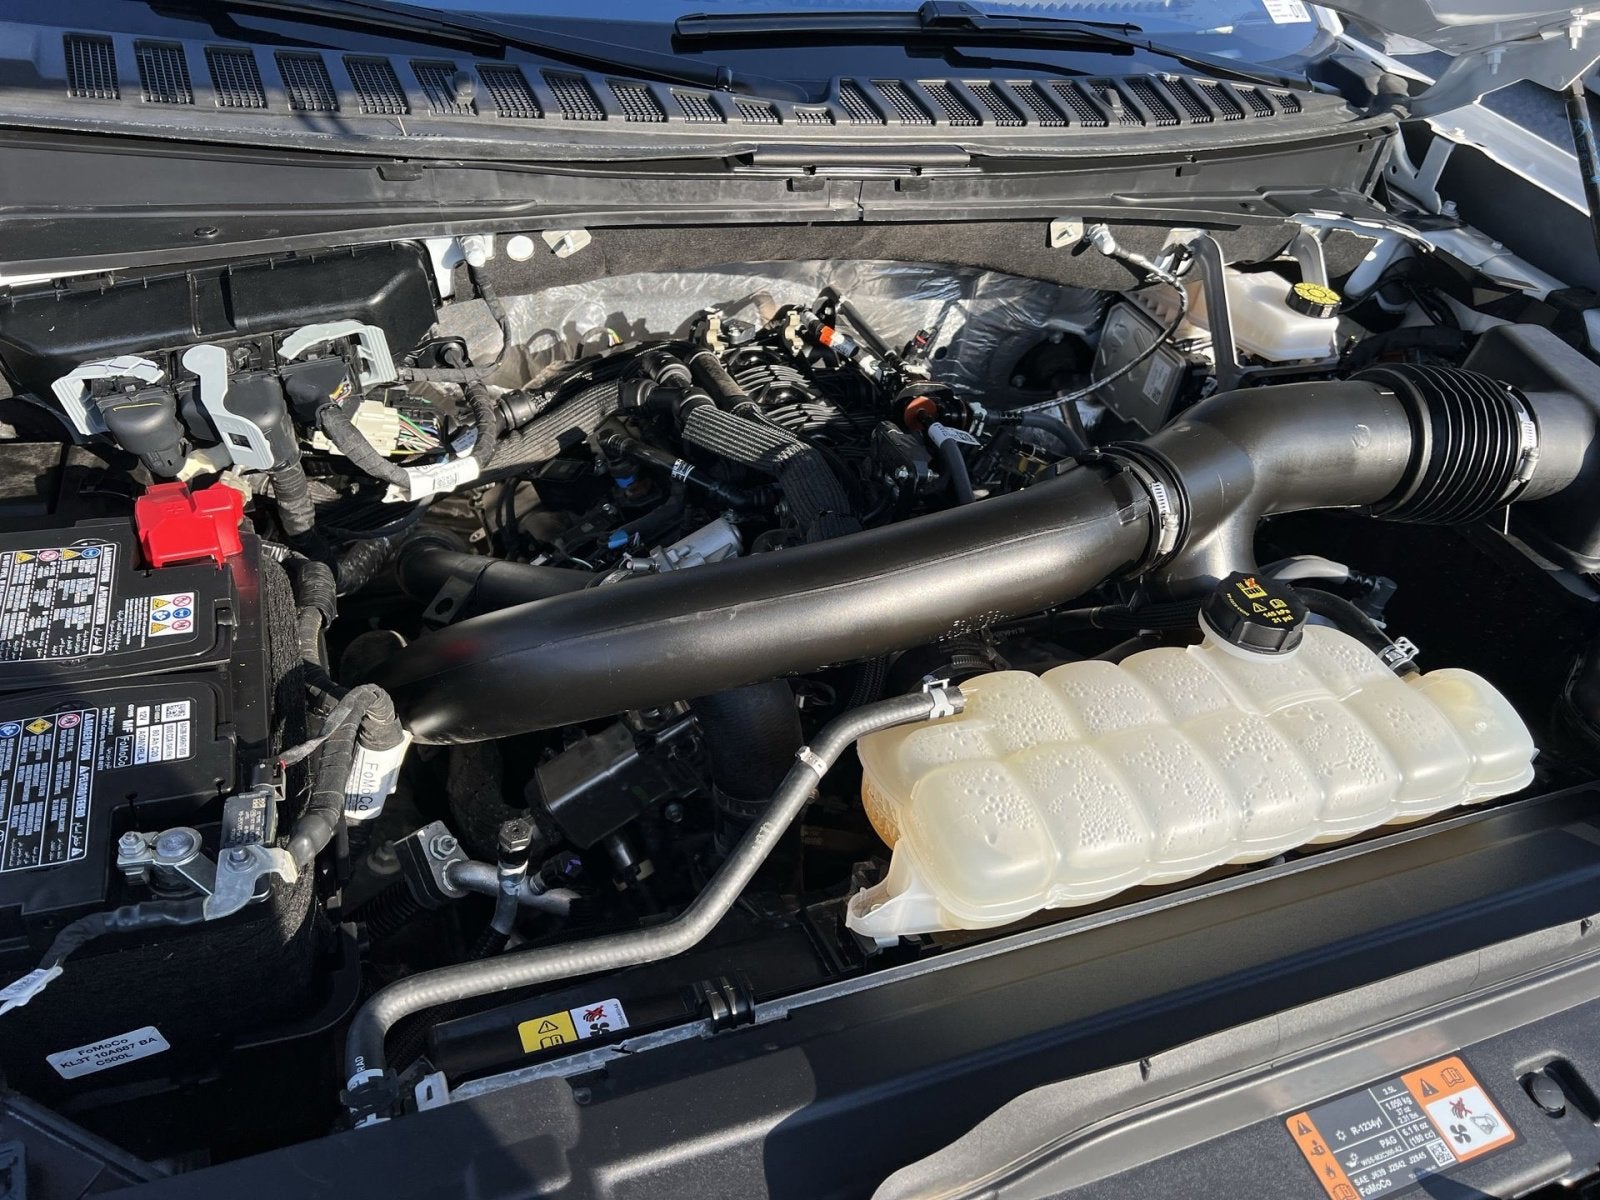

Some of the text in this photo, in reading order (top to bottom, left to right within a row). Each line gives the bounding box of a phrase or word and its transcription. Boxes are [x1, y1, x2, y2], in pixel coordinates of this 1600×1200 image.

[118, 736, 129, 766] FoMoCo
[60, 1056, 90, 1069] KL3T
[139, 1037, 158, 1046] BA
[78, 1038, 128, 1056] FoMoCo
[96, 1052, 133, 1066] C500L
[355, 1056, 366, 1073] RAD
[1350, 1116, 1383, 1136] R-1234yf
[1402, 1126, 1413, 1136] 6.1
[1379, 1135, 1397, 1148] PAG
[1354, 1175, 1370, 1186] SAE
[1359, 1179, 1392, 1197] FoMoCo
